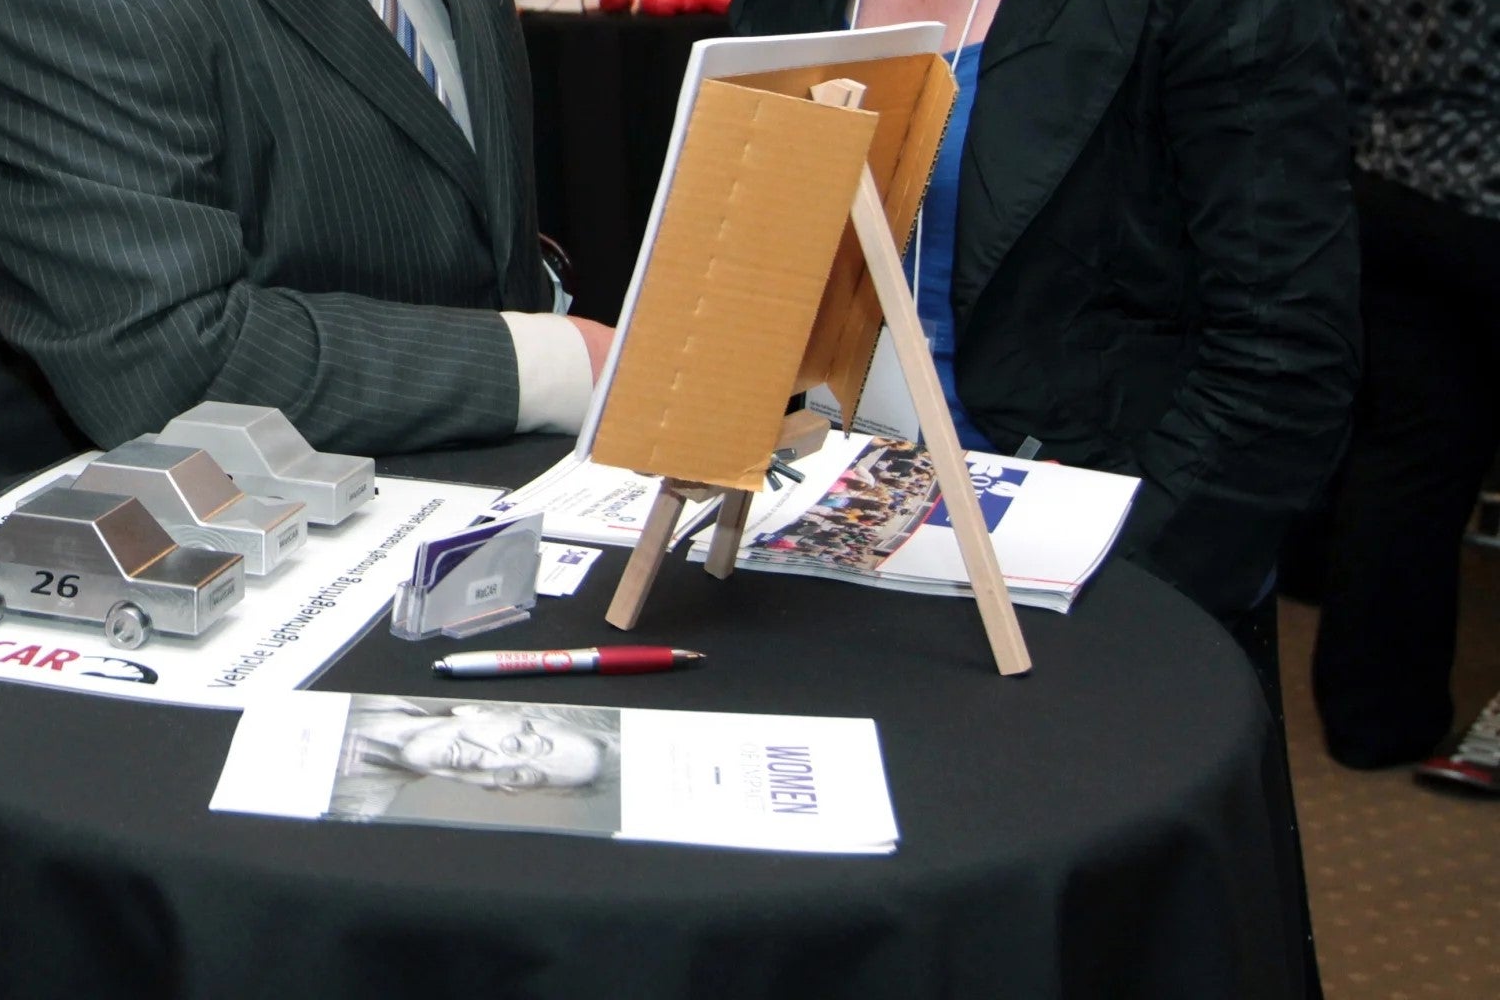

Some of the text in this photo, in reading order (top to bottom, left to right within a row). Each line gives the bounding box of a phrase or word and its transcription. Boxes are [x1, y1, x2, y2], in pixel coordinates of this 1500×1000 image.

[30, 570, 80, 598] 26
[207, 498, 446, 688] Vehicle Lightweighting through material selection
[765, 746, 819, 815] WOMEN
